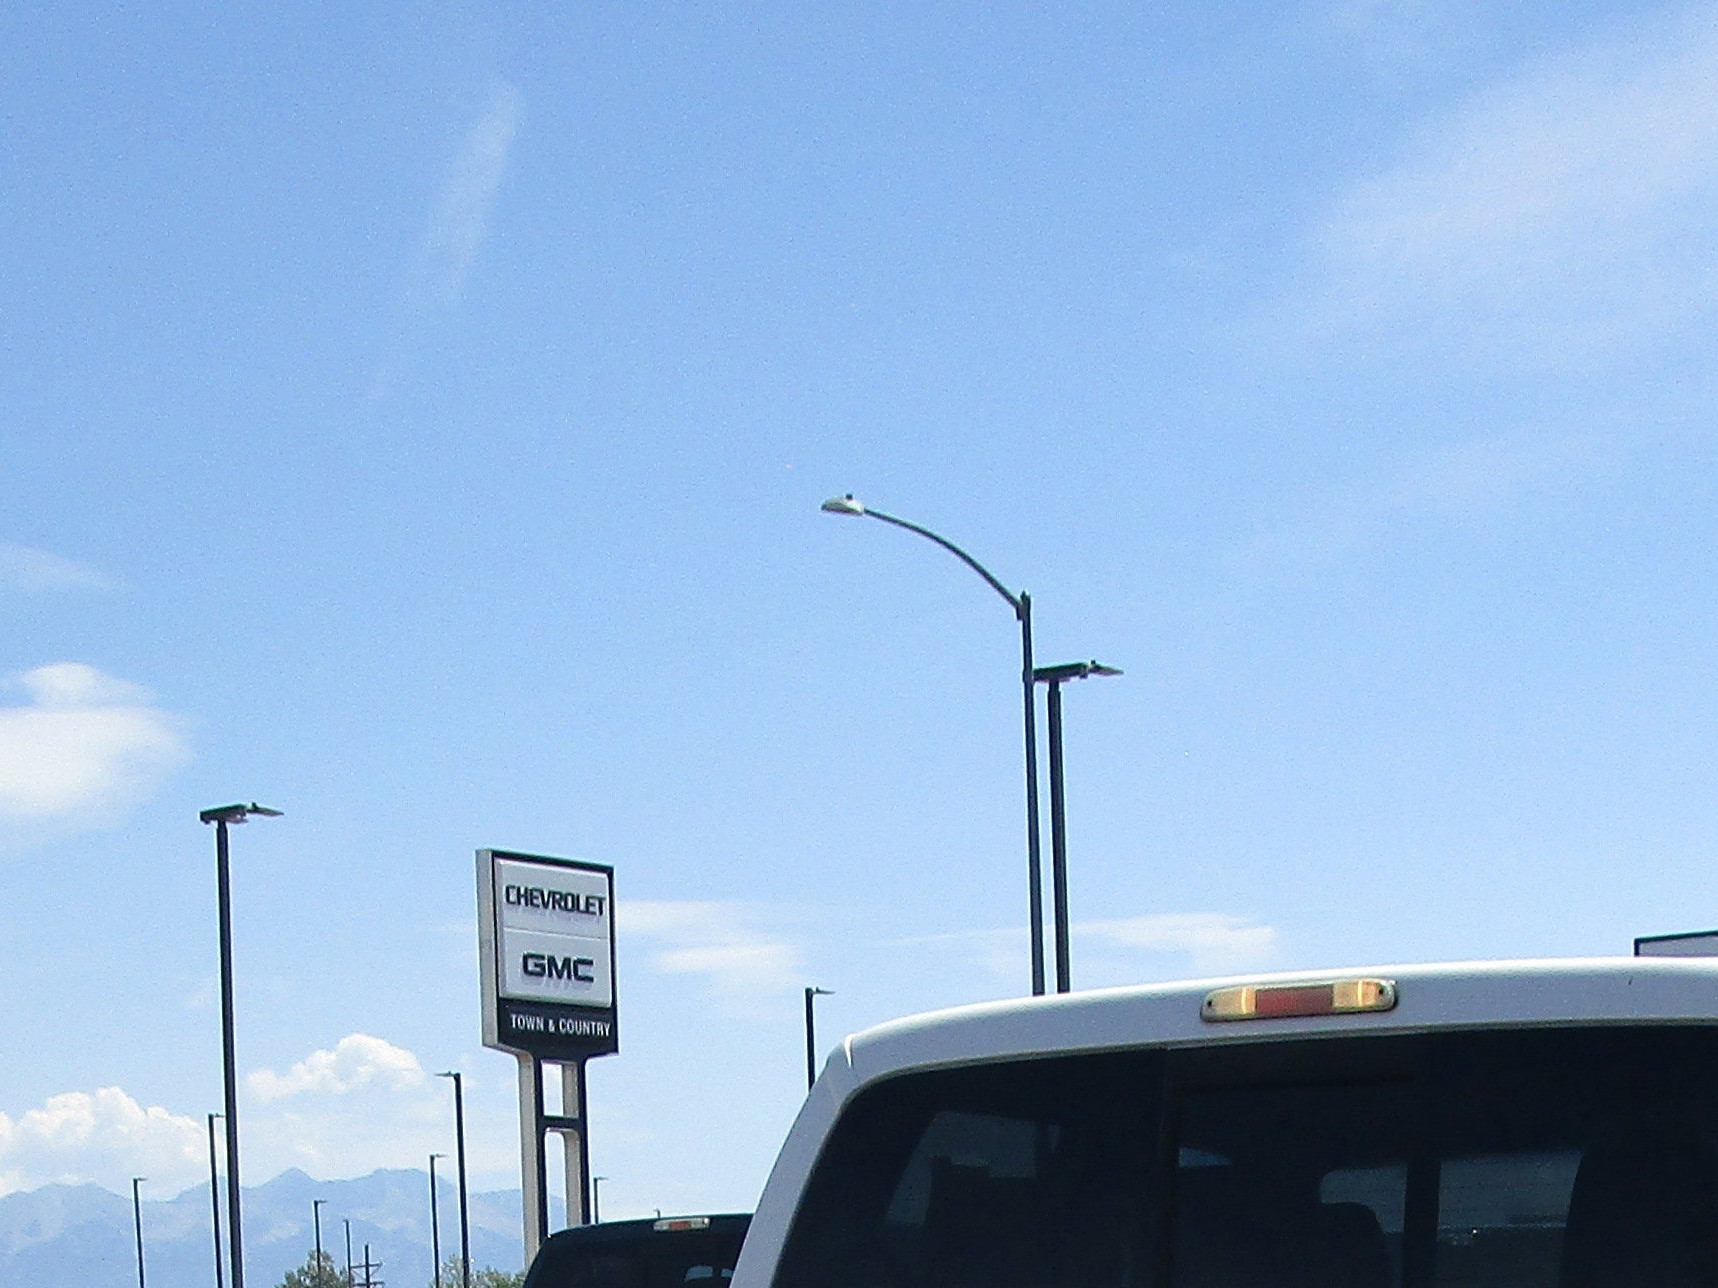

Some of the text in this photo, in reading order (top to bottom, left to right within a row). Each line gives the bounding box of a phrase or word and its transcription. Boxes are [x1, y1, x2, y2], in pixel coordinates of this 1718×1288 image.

[505, 884, 606, 916] CHEVROLET
[523, 952, 595, 983] GMC
[510, 1013, 611, 1037] TOWN & COUNTRY
